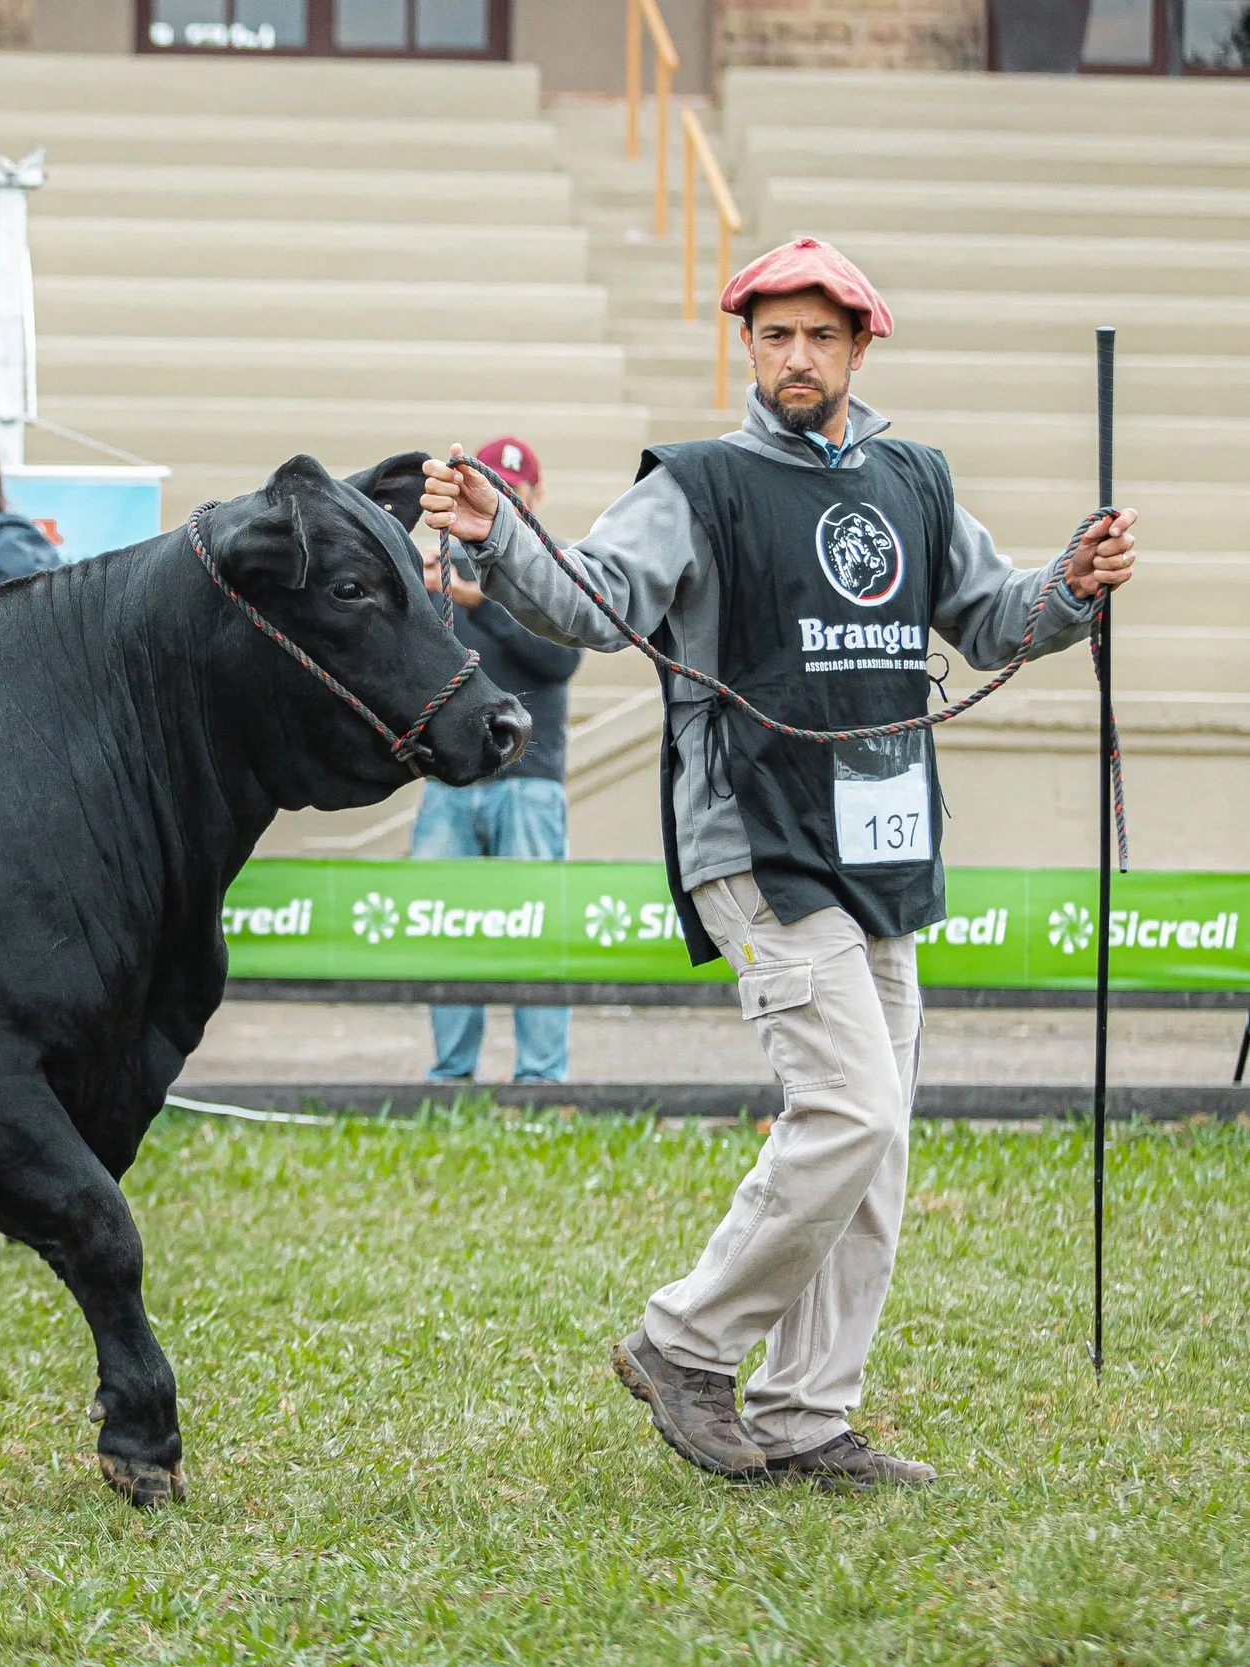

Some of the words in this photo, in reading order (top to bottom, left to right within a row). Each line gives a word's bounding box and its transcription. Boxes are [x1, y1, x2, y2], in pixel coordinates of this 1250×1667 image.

[805, 658, 855, 673] ASSOCIAÇÃO
[894, 659, 902, 670] DE
[865, 812, 919, 850] 137
[405, 900, 545, 939] Sicredi
[1108, 910, 1239, 949] Sicredi
